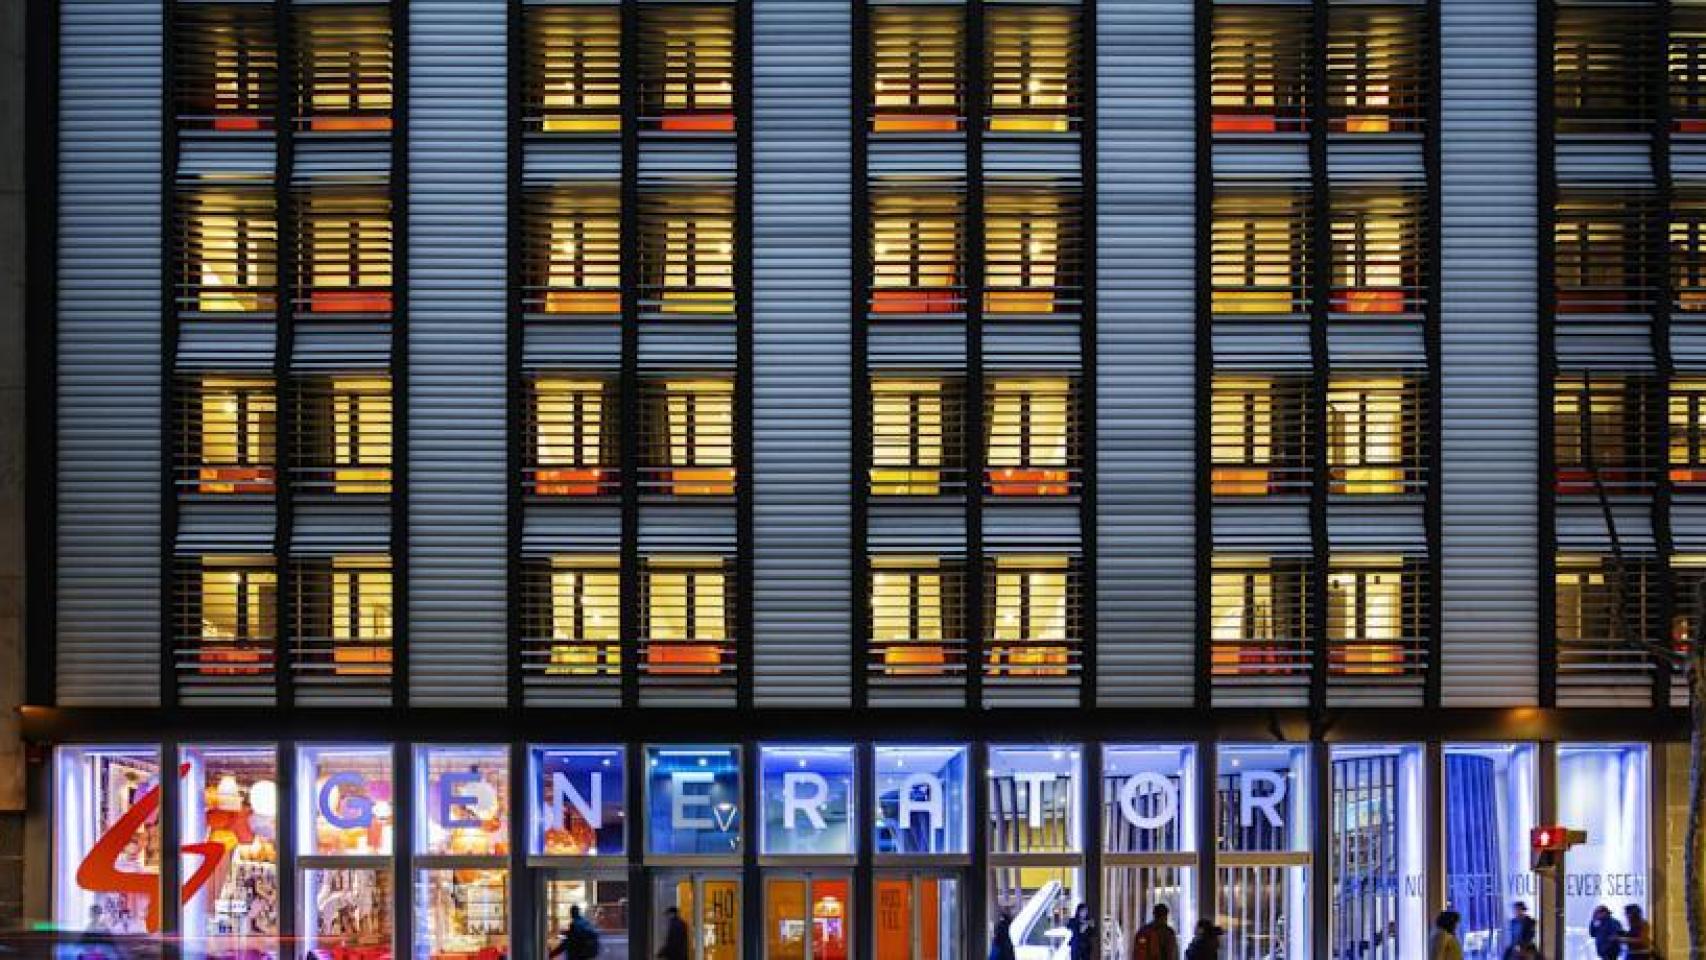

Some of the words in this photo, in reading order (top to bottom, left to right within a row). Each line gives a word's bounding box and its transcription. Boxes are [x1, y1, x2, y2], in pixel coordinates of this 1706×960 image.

[319, 770, 1285, 830] GENERATOR
[1567, 873, 1602, 896] EVER
[1607, 873, 1644, 896] SEEN
